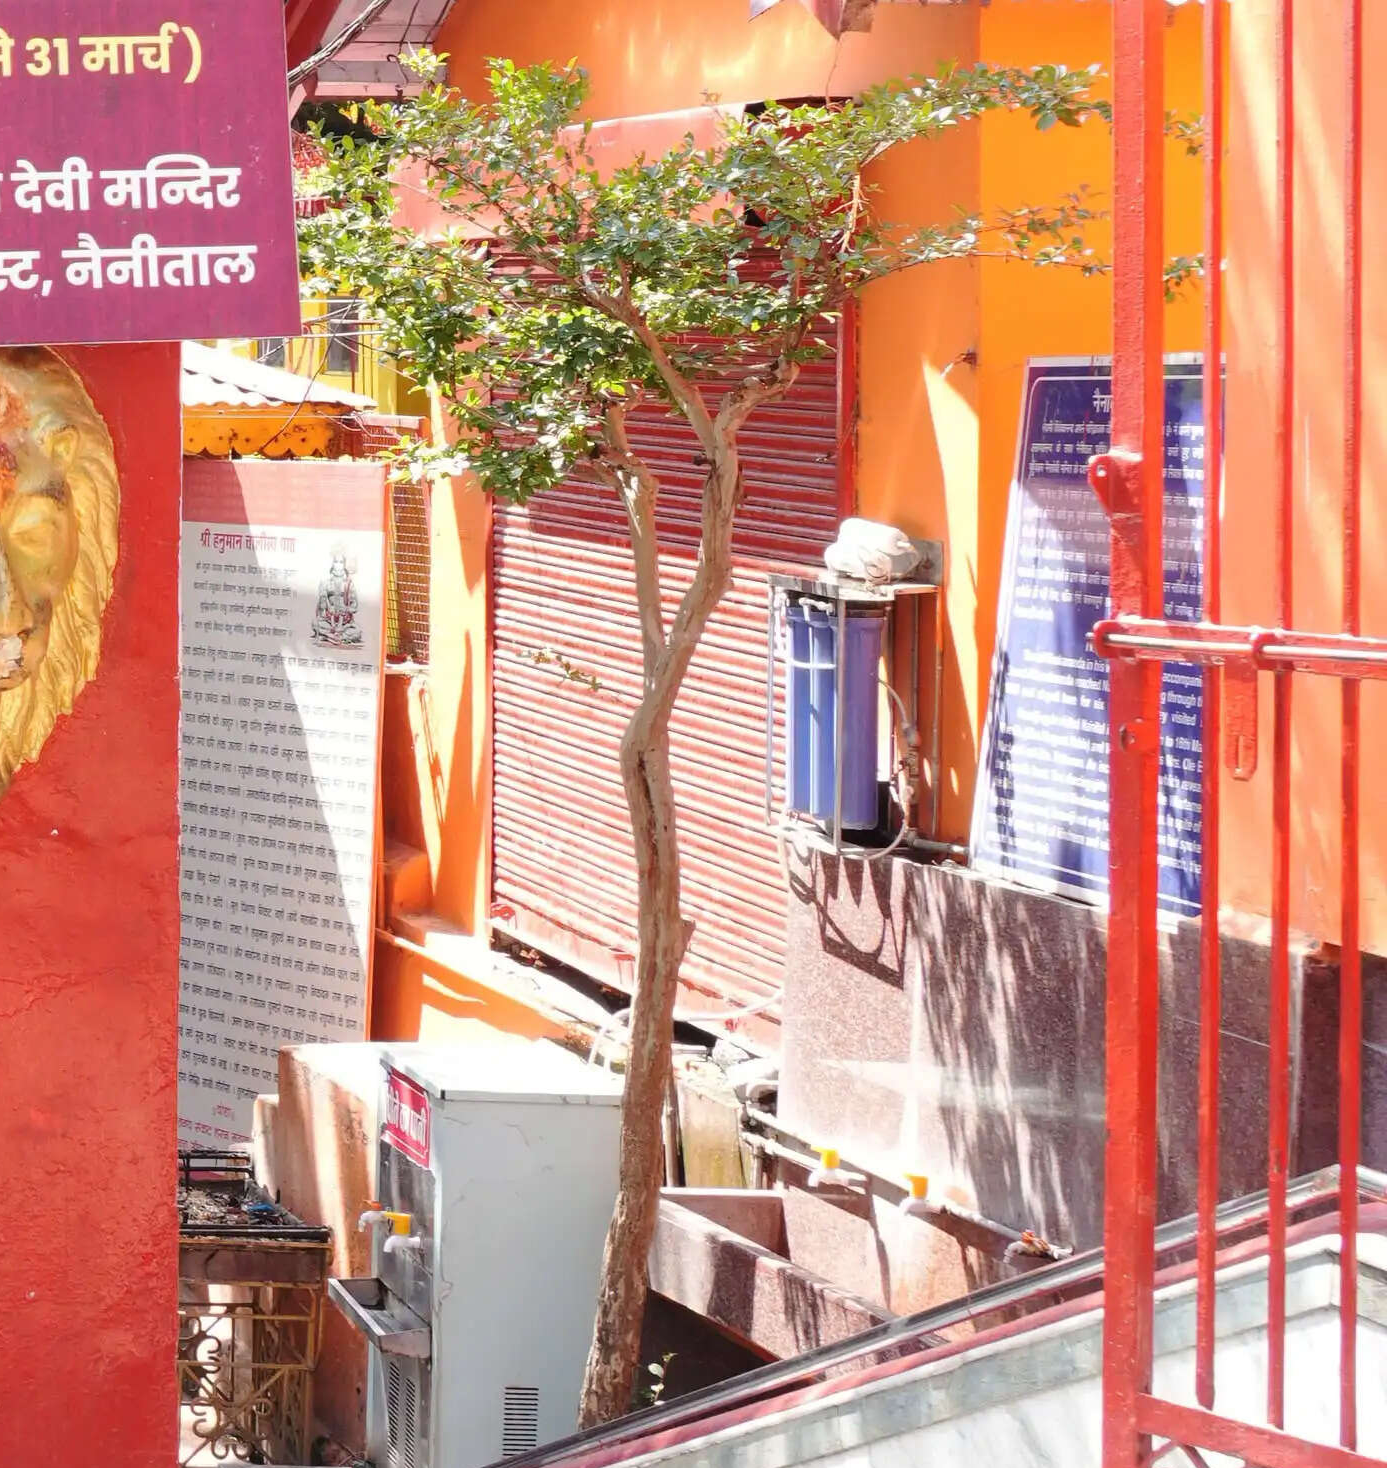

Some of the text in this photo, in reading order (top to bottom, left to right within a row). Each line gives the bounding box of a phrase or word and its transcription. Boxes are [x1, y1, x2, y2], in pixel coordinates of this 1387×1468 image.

[25, 36, 68, 76] 31
[11, 157, 92, 211] देवी
[99, 154, 242, 209] मन्दिर
[61, 233, 258, 290] नैनीताल
[212, 533, 244, 554] हनुमान
